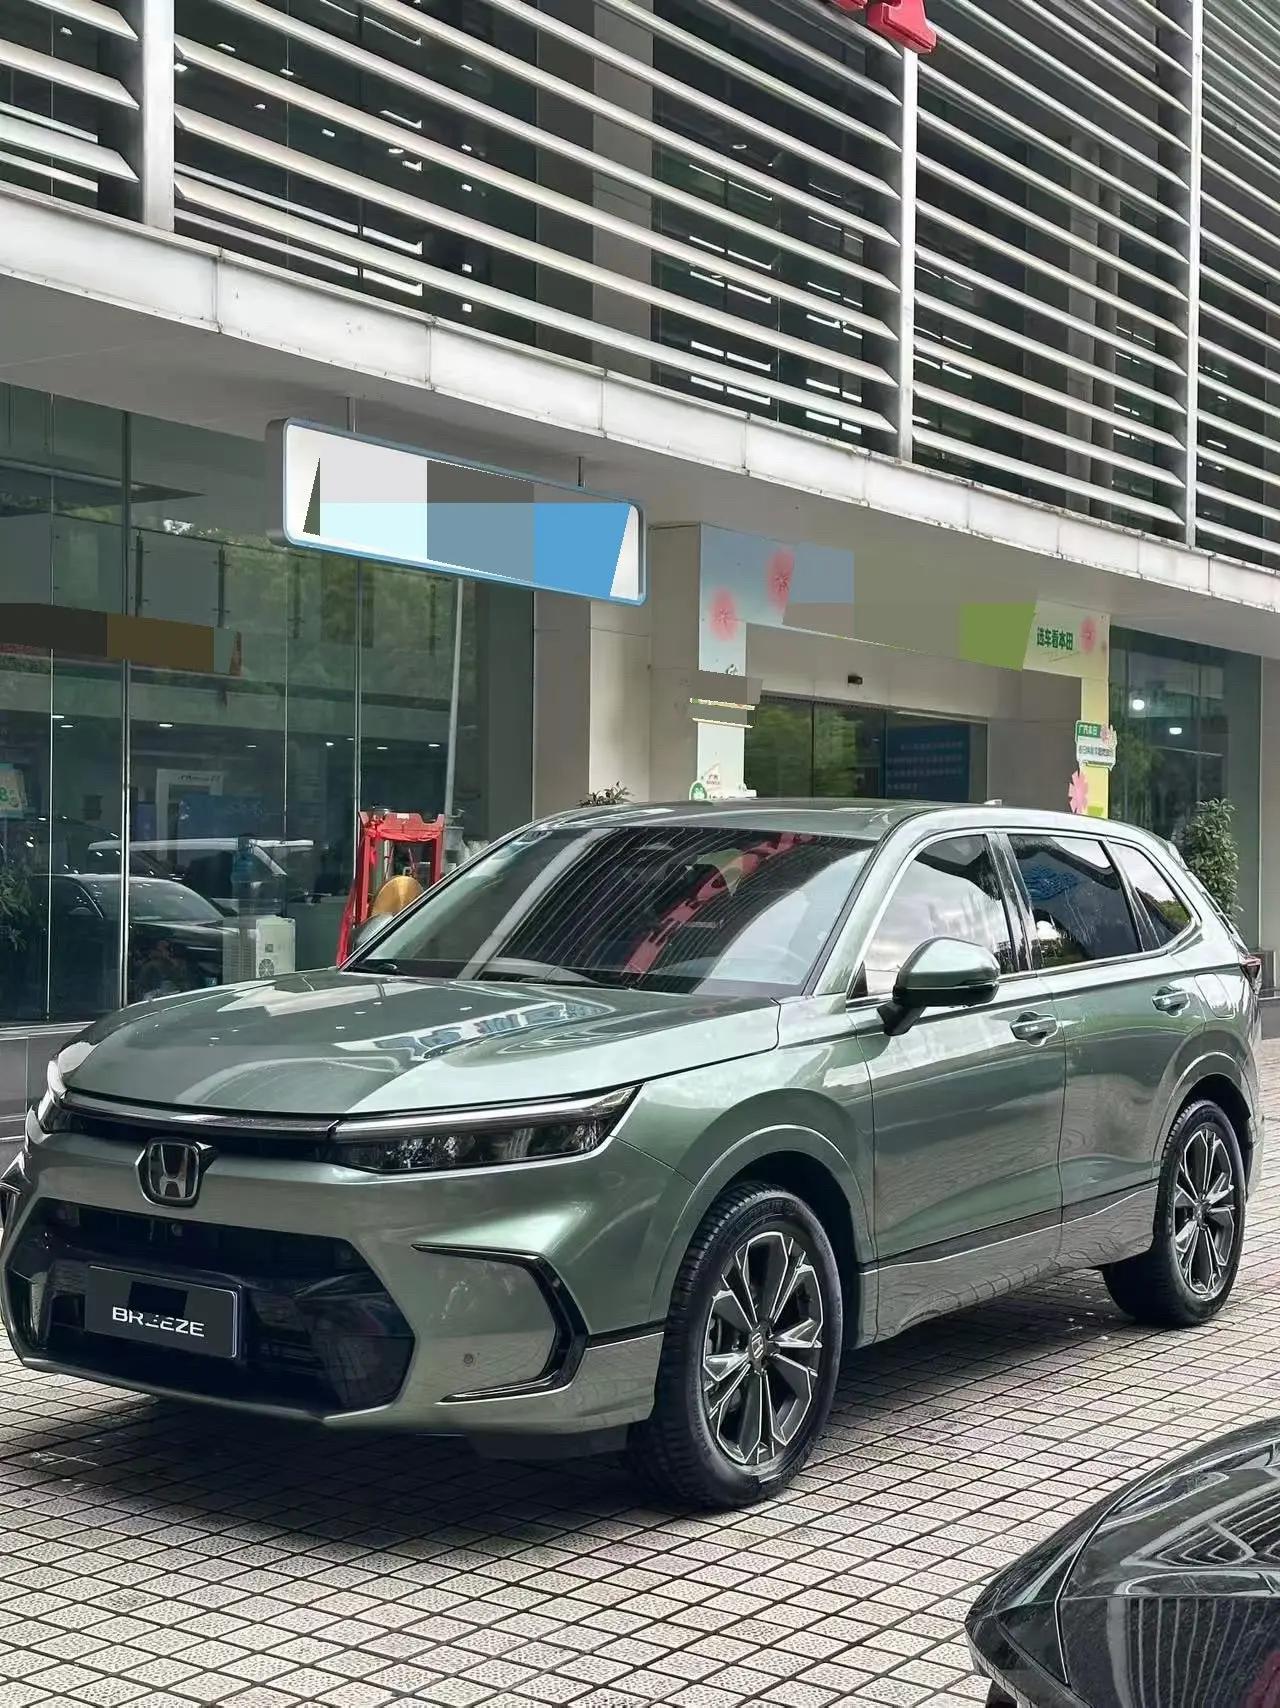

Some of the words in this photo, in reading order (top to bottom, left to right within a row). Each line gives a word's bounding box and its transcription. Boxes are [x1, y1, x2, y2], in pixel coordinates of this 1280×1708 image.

[1036, 626, 1074, 651] 选车看本田
